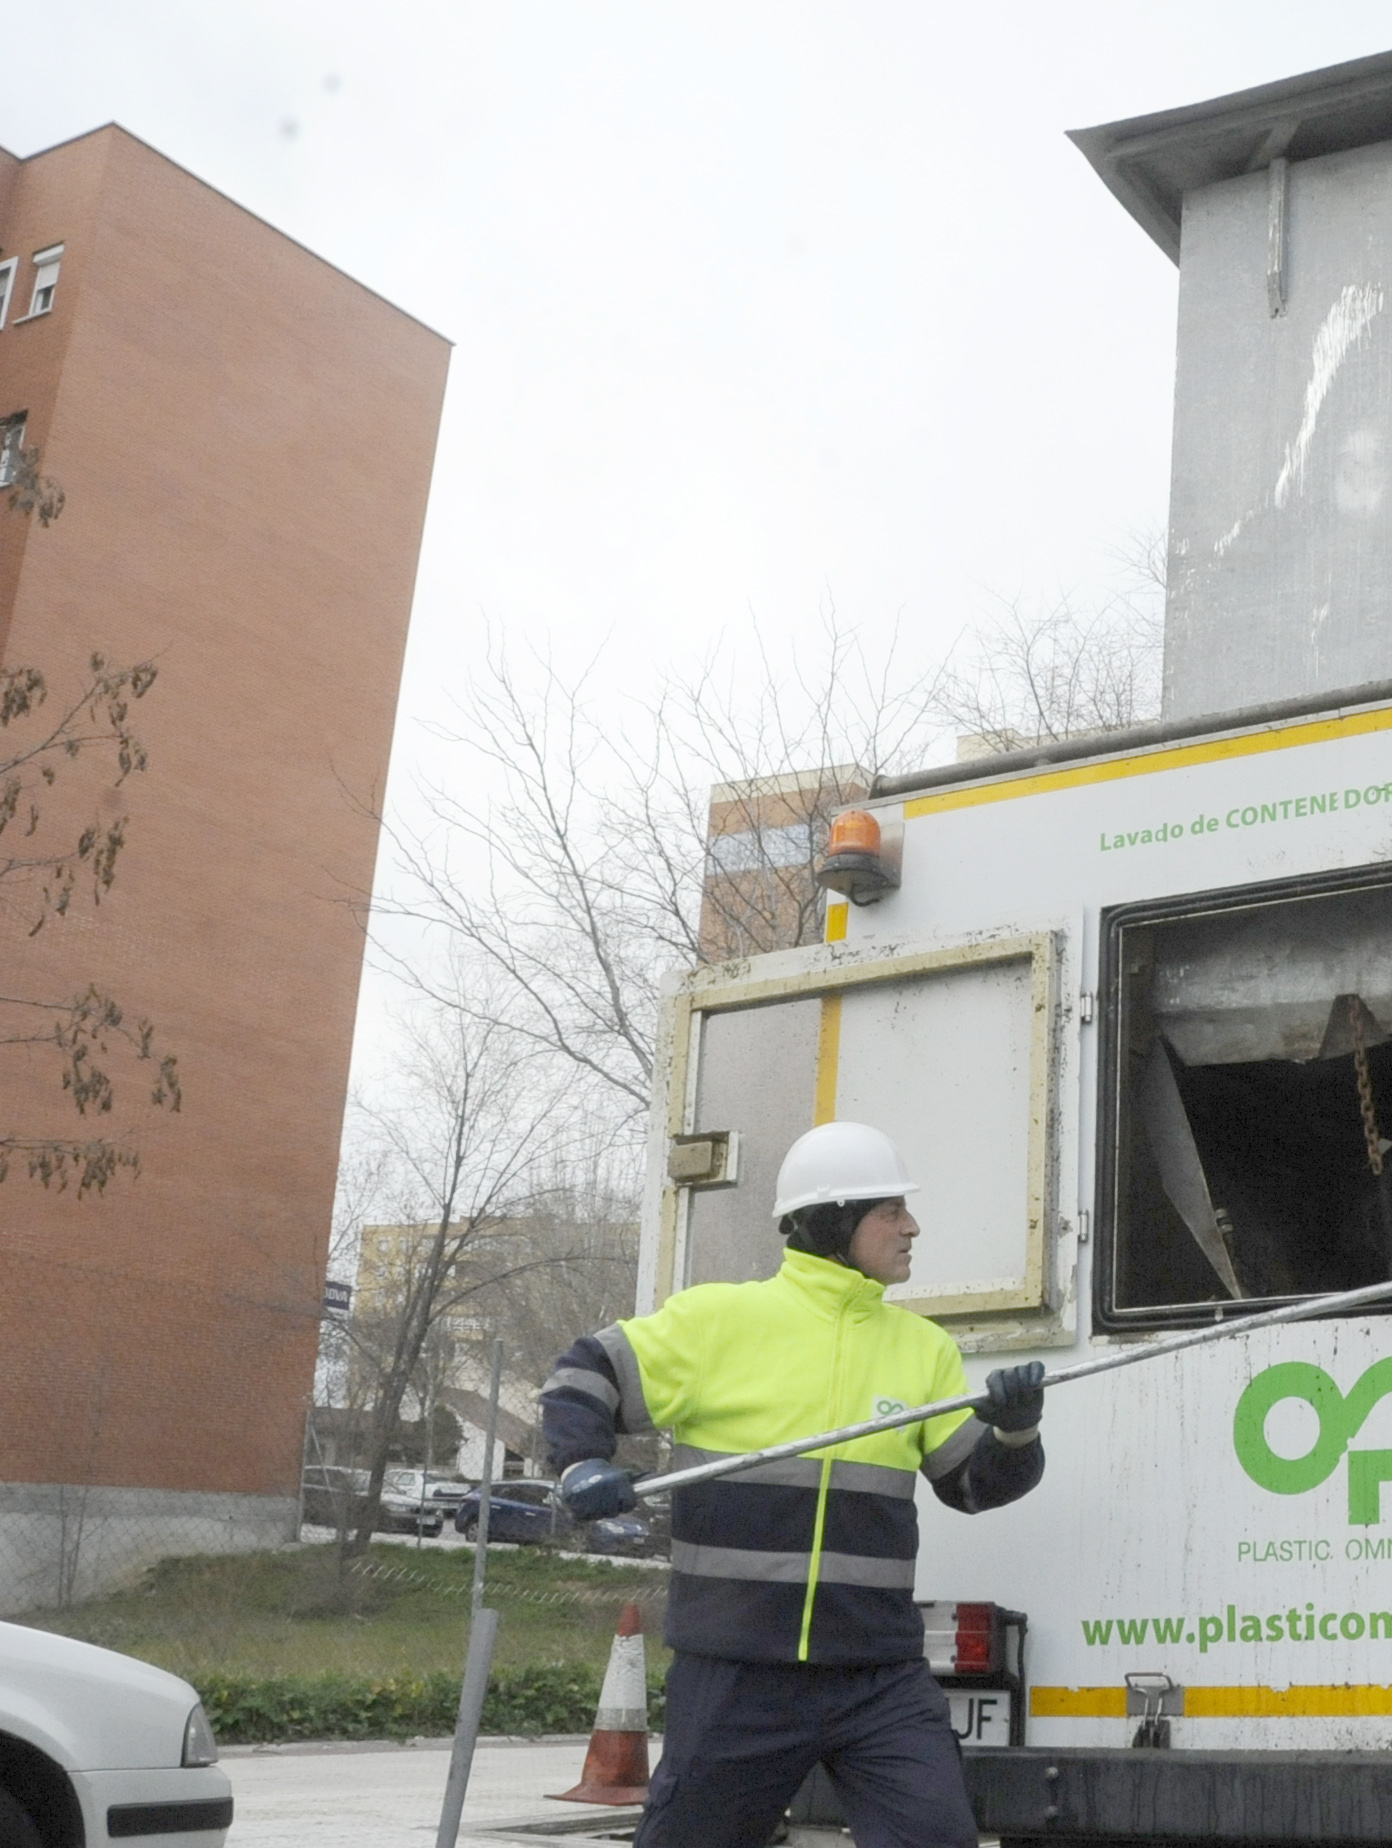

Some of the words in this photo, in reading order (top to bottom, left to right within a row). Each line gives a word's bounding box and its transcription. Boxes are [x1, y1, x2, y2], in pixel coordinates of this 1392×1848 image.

[1099, 823, 1185, 852] Lavado
[1189, 813, 1220, 836] de
[1237, 1538, 1330, 1564] PLASTIC
